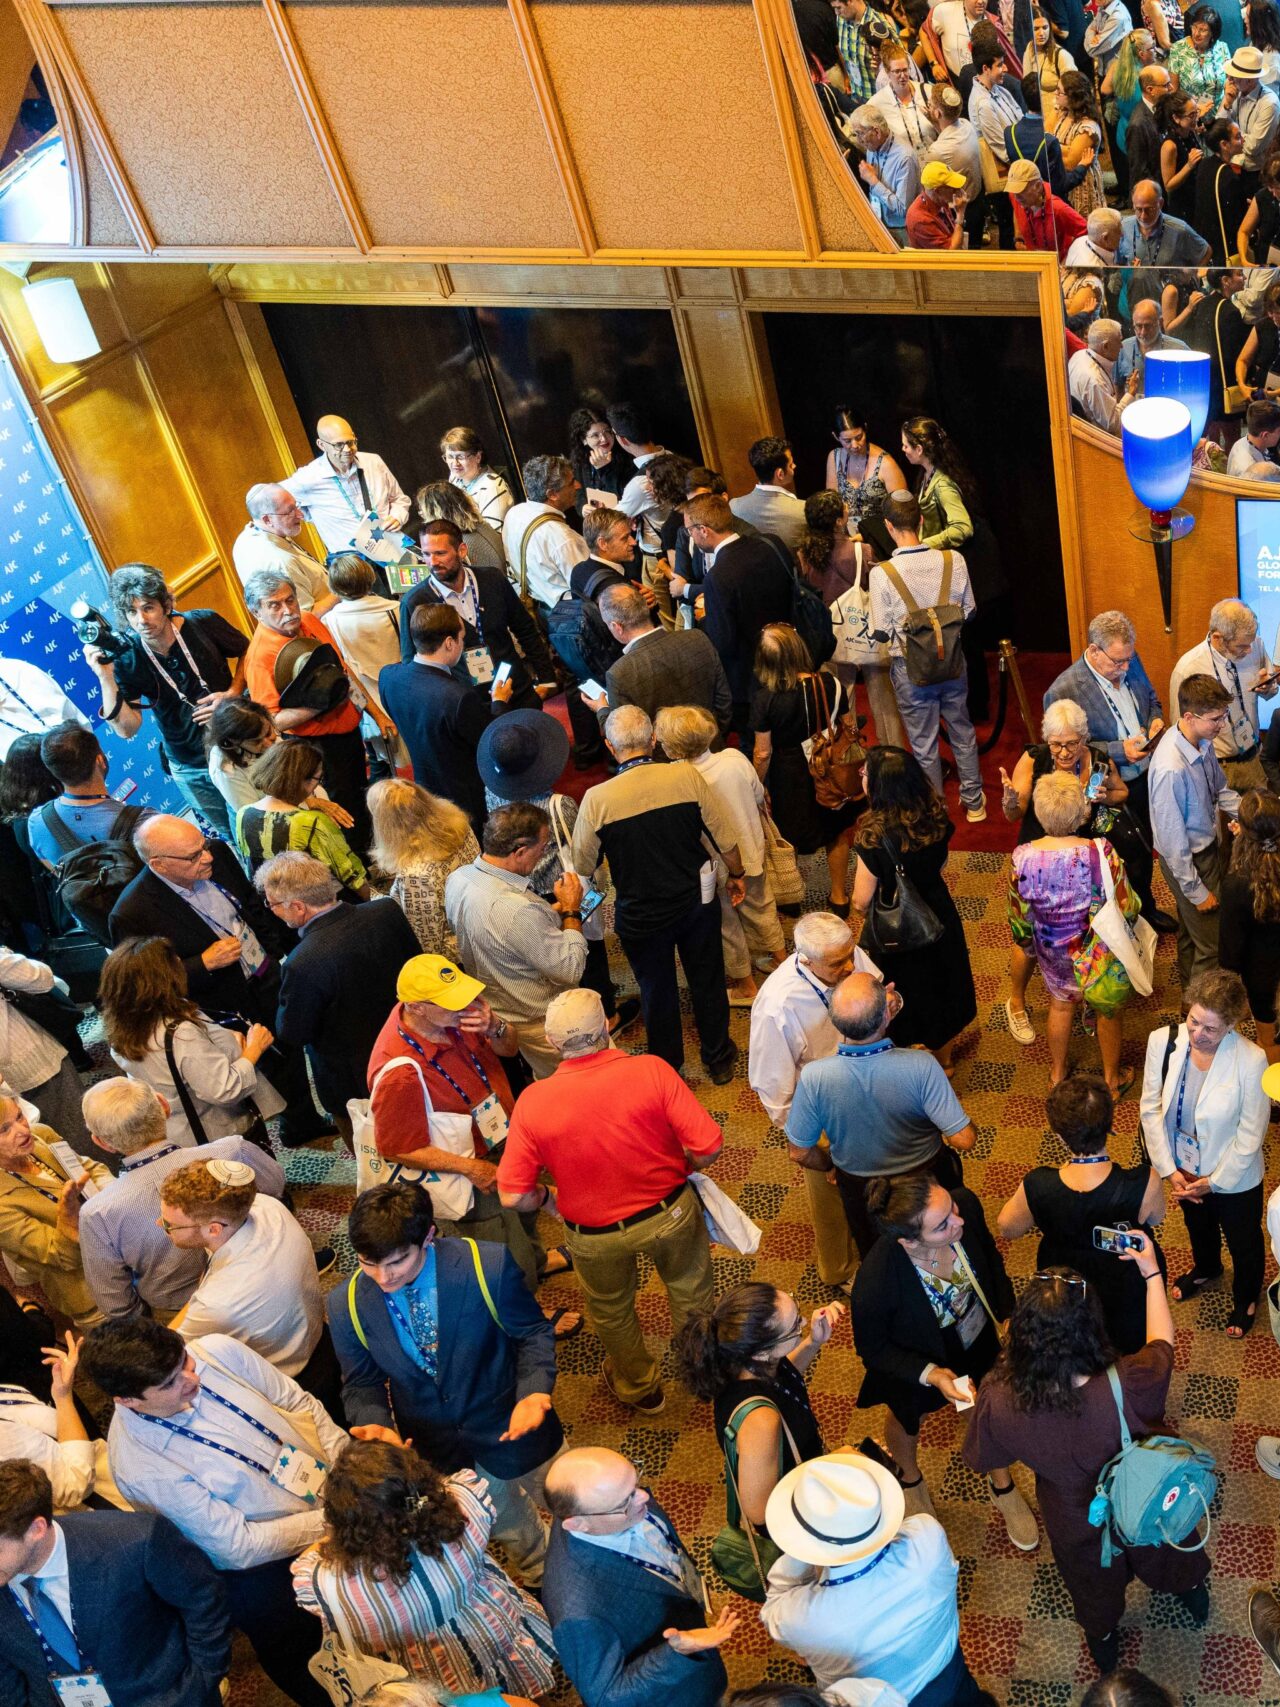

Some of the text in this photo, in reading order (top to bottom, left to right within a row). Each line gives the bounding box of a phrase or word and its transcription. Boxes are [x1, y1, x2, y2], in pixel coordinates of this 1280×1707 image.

[18, 470, 32, 484] AJC
[42, 483, 54, 496] AJC
[13, 500, 27, 514] AJC
[38, 512, 52, 526] AJC
[61, 523, 74, 536] AJC
[9, 530, 23, 544] AJC
[33, 541, 46, 556] AJC
[57, 552, 71, 566] AJC
[4, 560, 18, 575] AJC
[30, 570, 43, 586] AJC
[53, 581, 66, 595] AJC
[1, 590, 15, 605] AJC
[24, 600, 39, 615] AJC
[49, 611, 63, 624] AJC
[20, 630, 35, 645] AJC
[44, 640, 58, 654] AJC
[68, 649, 82, 663] AJC
[64, 678, 78, 692] AJC
[87, 686, 100, 700] AJC
[147, 737, 159, 751] AJC
[122, 758, 135, 772] AJC
[144, 765, 156, 778] AJC
[140, 792, 152, 806] AJC
